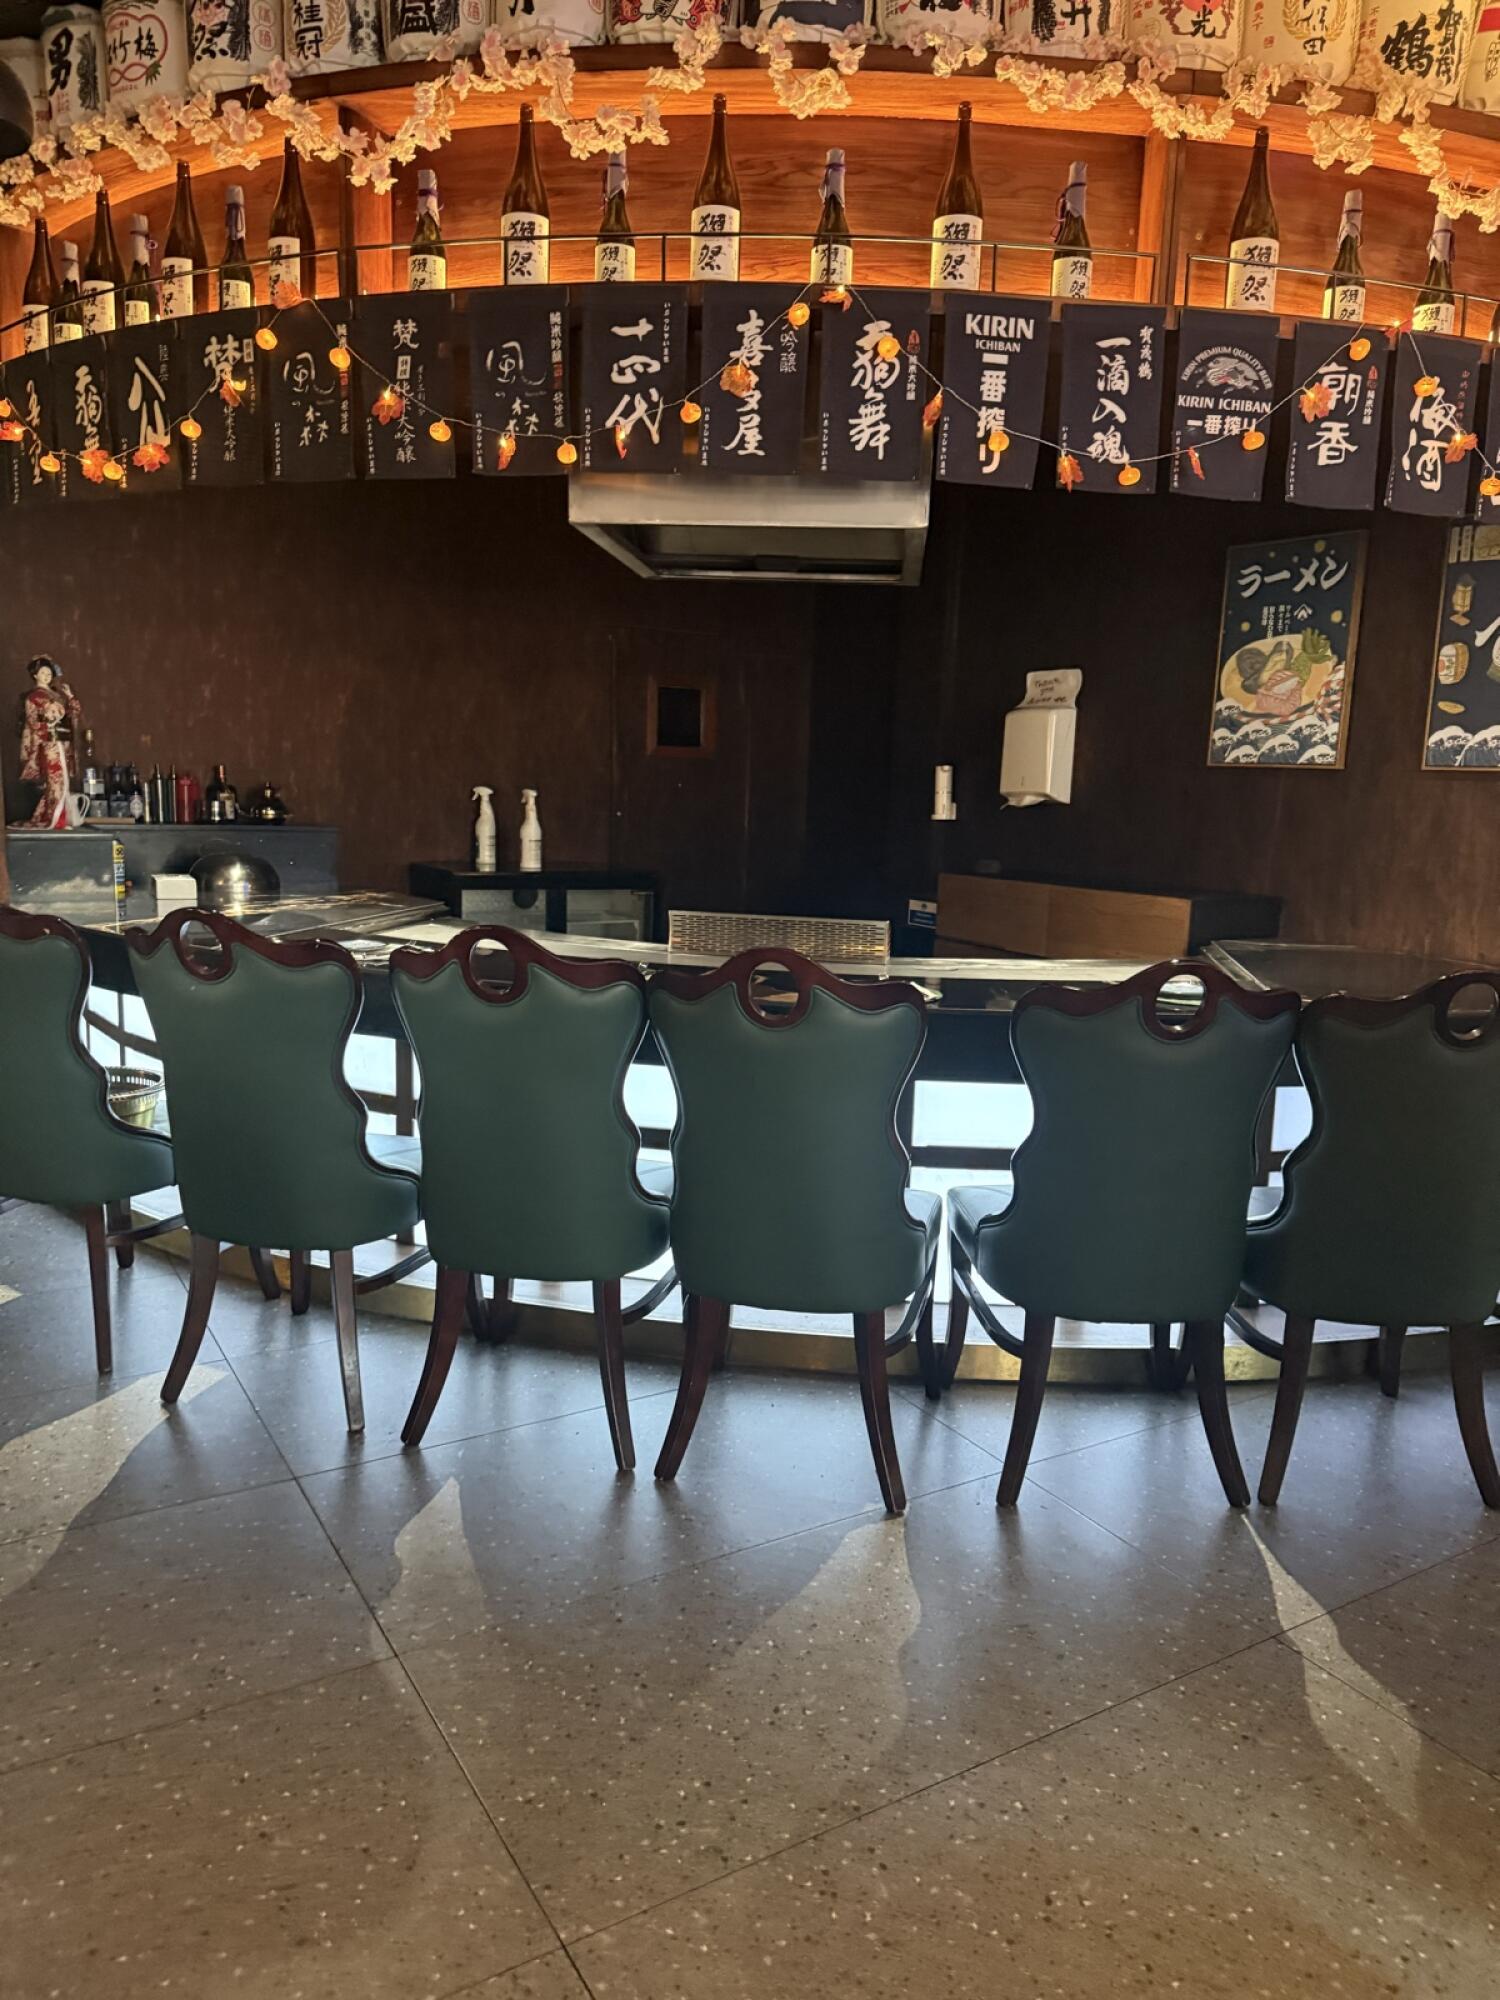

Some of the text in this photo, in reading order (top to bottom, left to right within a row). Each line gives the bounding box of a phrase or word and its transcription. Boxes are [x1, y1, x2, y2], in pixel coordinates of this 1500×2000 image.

[698, 213, 728, 271] 獺祭
[942, 222, 970, 281] 獺祭
[1240, 245, 1272, 302] 獺祭
[392, 319, 420, 350] 梵
[965, 313, 1035, 340] KIRIN
[975, 339, 1021, 353] ICHIBAN
[605, 317, 661, 445] 十四代
[1087, 337, 1131, 464] 一滴入魂
[1177, 395, 1272, 413] KIRIN ICHIBAN
[976, 353, 1009, 474] 一番搾り
[1187, 415, 1257, 436] 一番搾り
[1237, 556, 1349, 598] ラーメン
